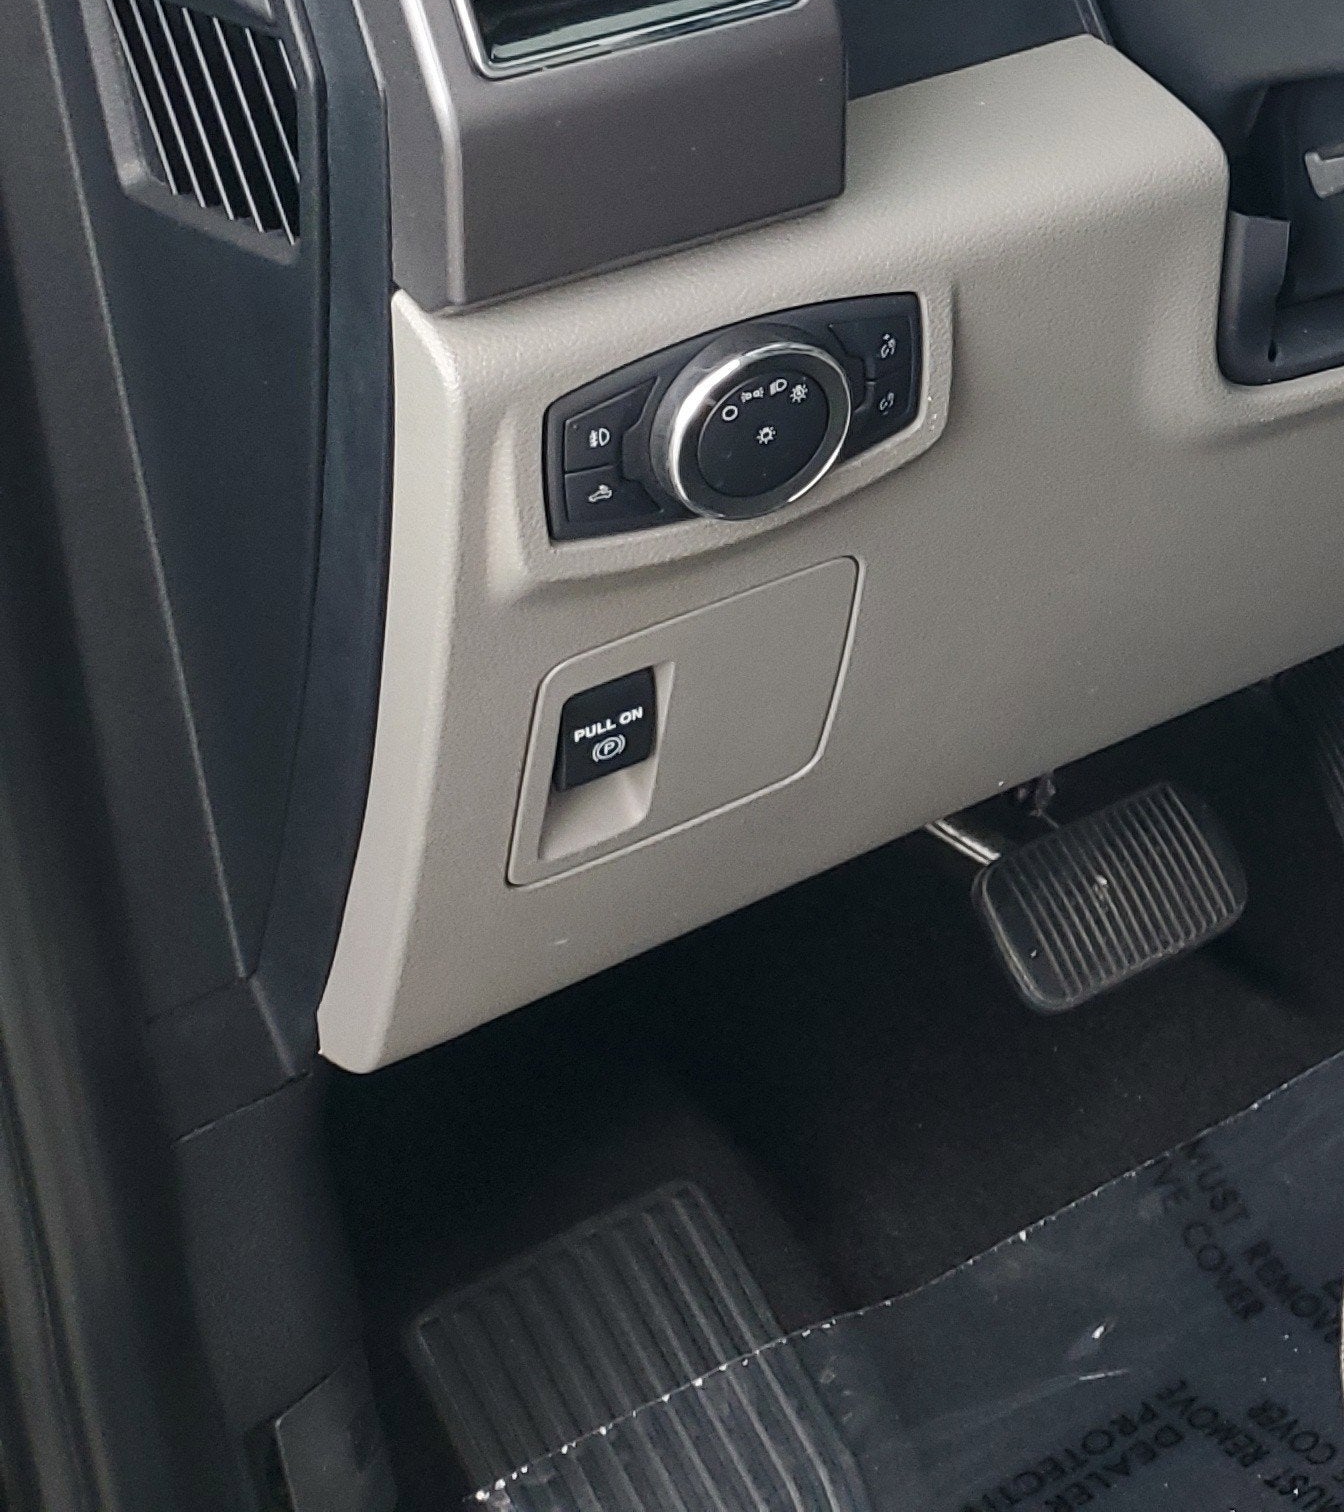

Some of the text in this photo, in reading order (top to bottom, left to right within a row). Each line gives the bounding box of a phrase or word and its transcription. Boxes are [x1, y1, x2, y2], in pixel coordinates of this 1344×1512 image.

[574, 706, 643, 743] PULL ON
[1183, 1221, 1265, 1321] COVER
[1157, 1380, 1270, 1468] REMOVE
[1247, 1399, 1337, 1467] COVER
[1044, 1425, 1183, 1512] DEALER
